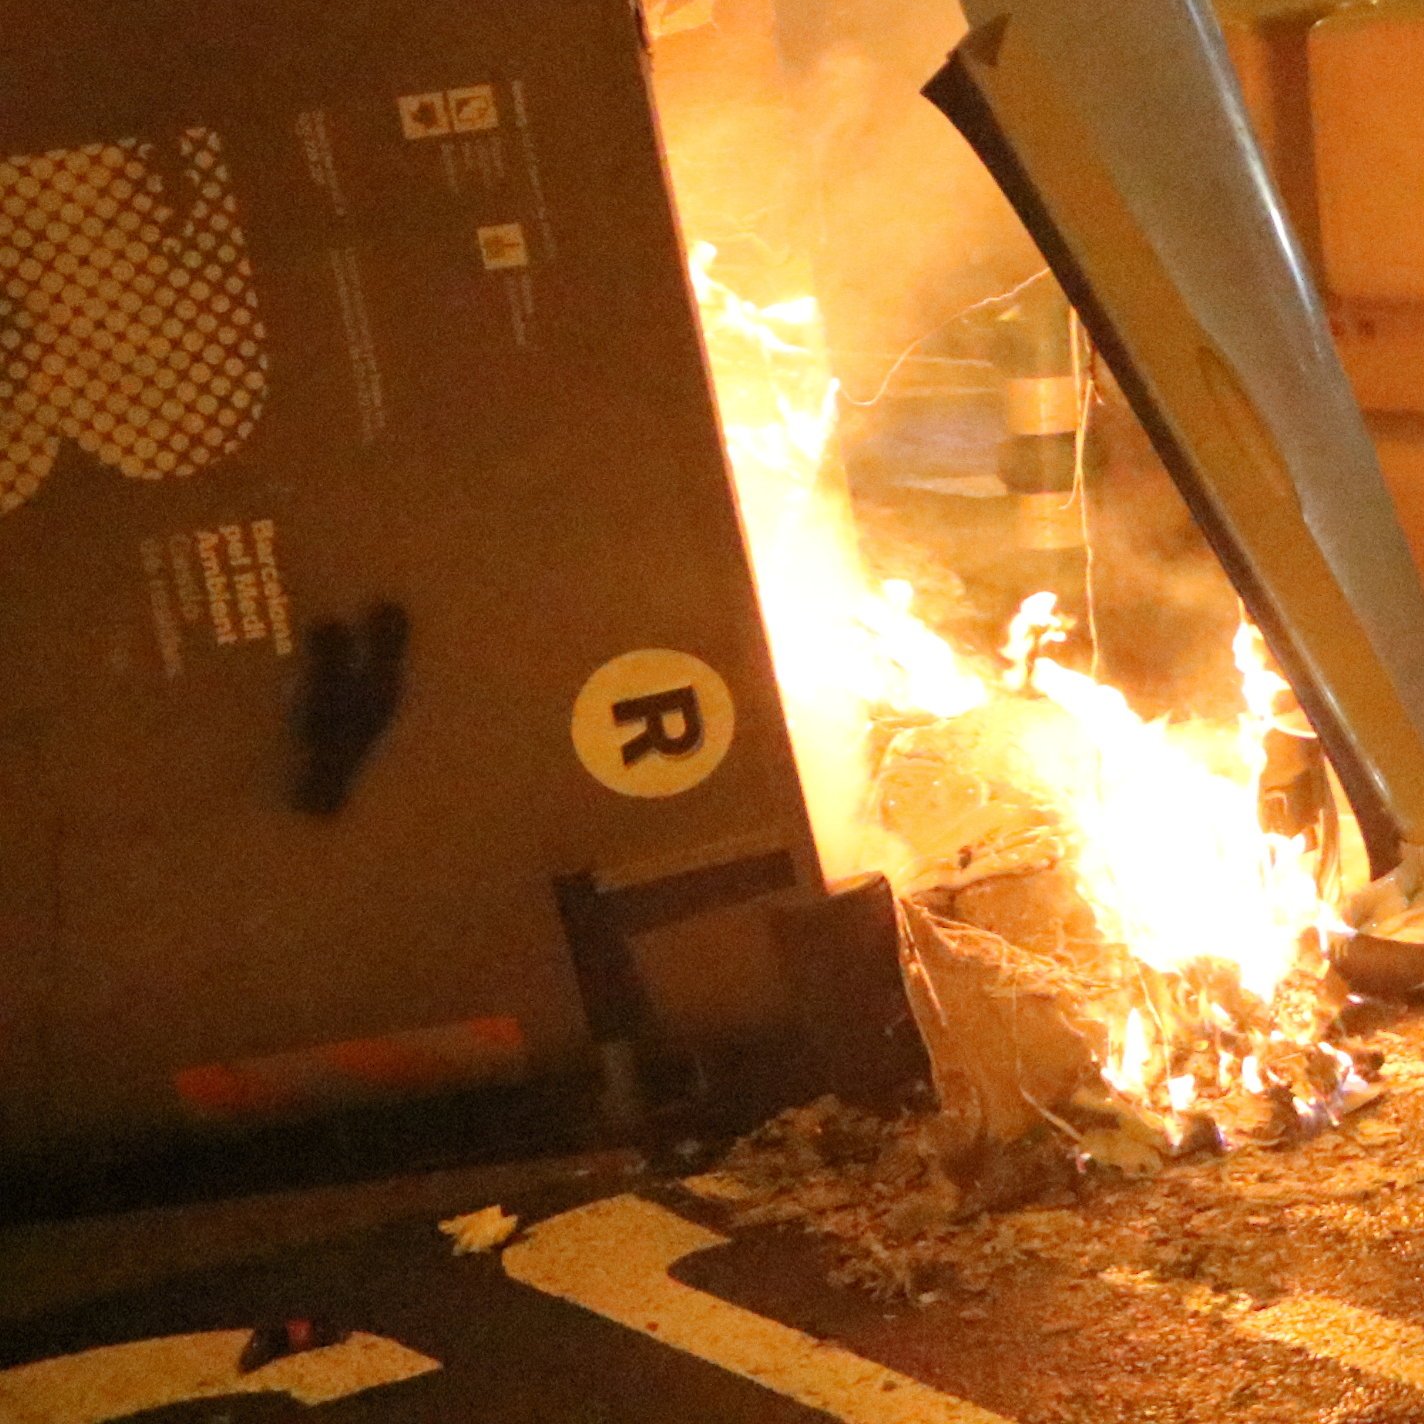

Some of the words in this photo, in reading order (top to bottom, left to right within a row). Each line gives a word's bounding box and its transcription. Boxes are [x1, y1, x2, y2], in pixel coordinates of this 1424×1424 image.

[197, 530, 237, 646] Ambient
[234, 572, 267, 639] Medi
[251, 518, 293, 655] Barcelona
[610, 686, 704, 767] R
